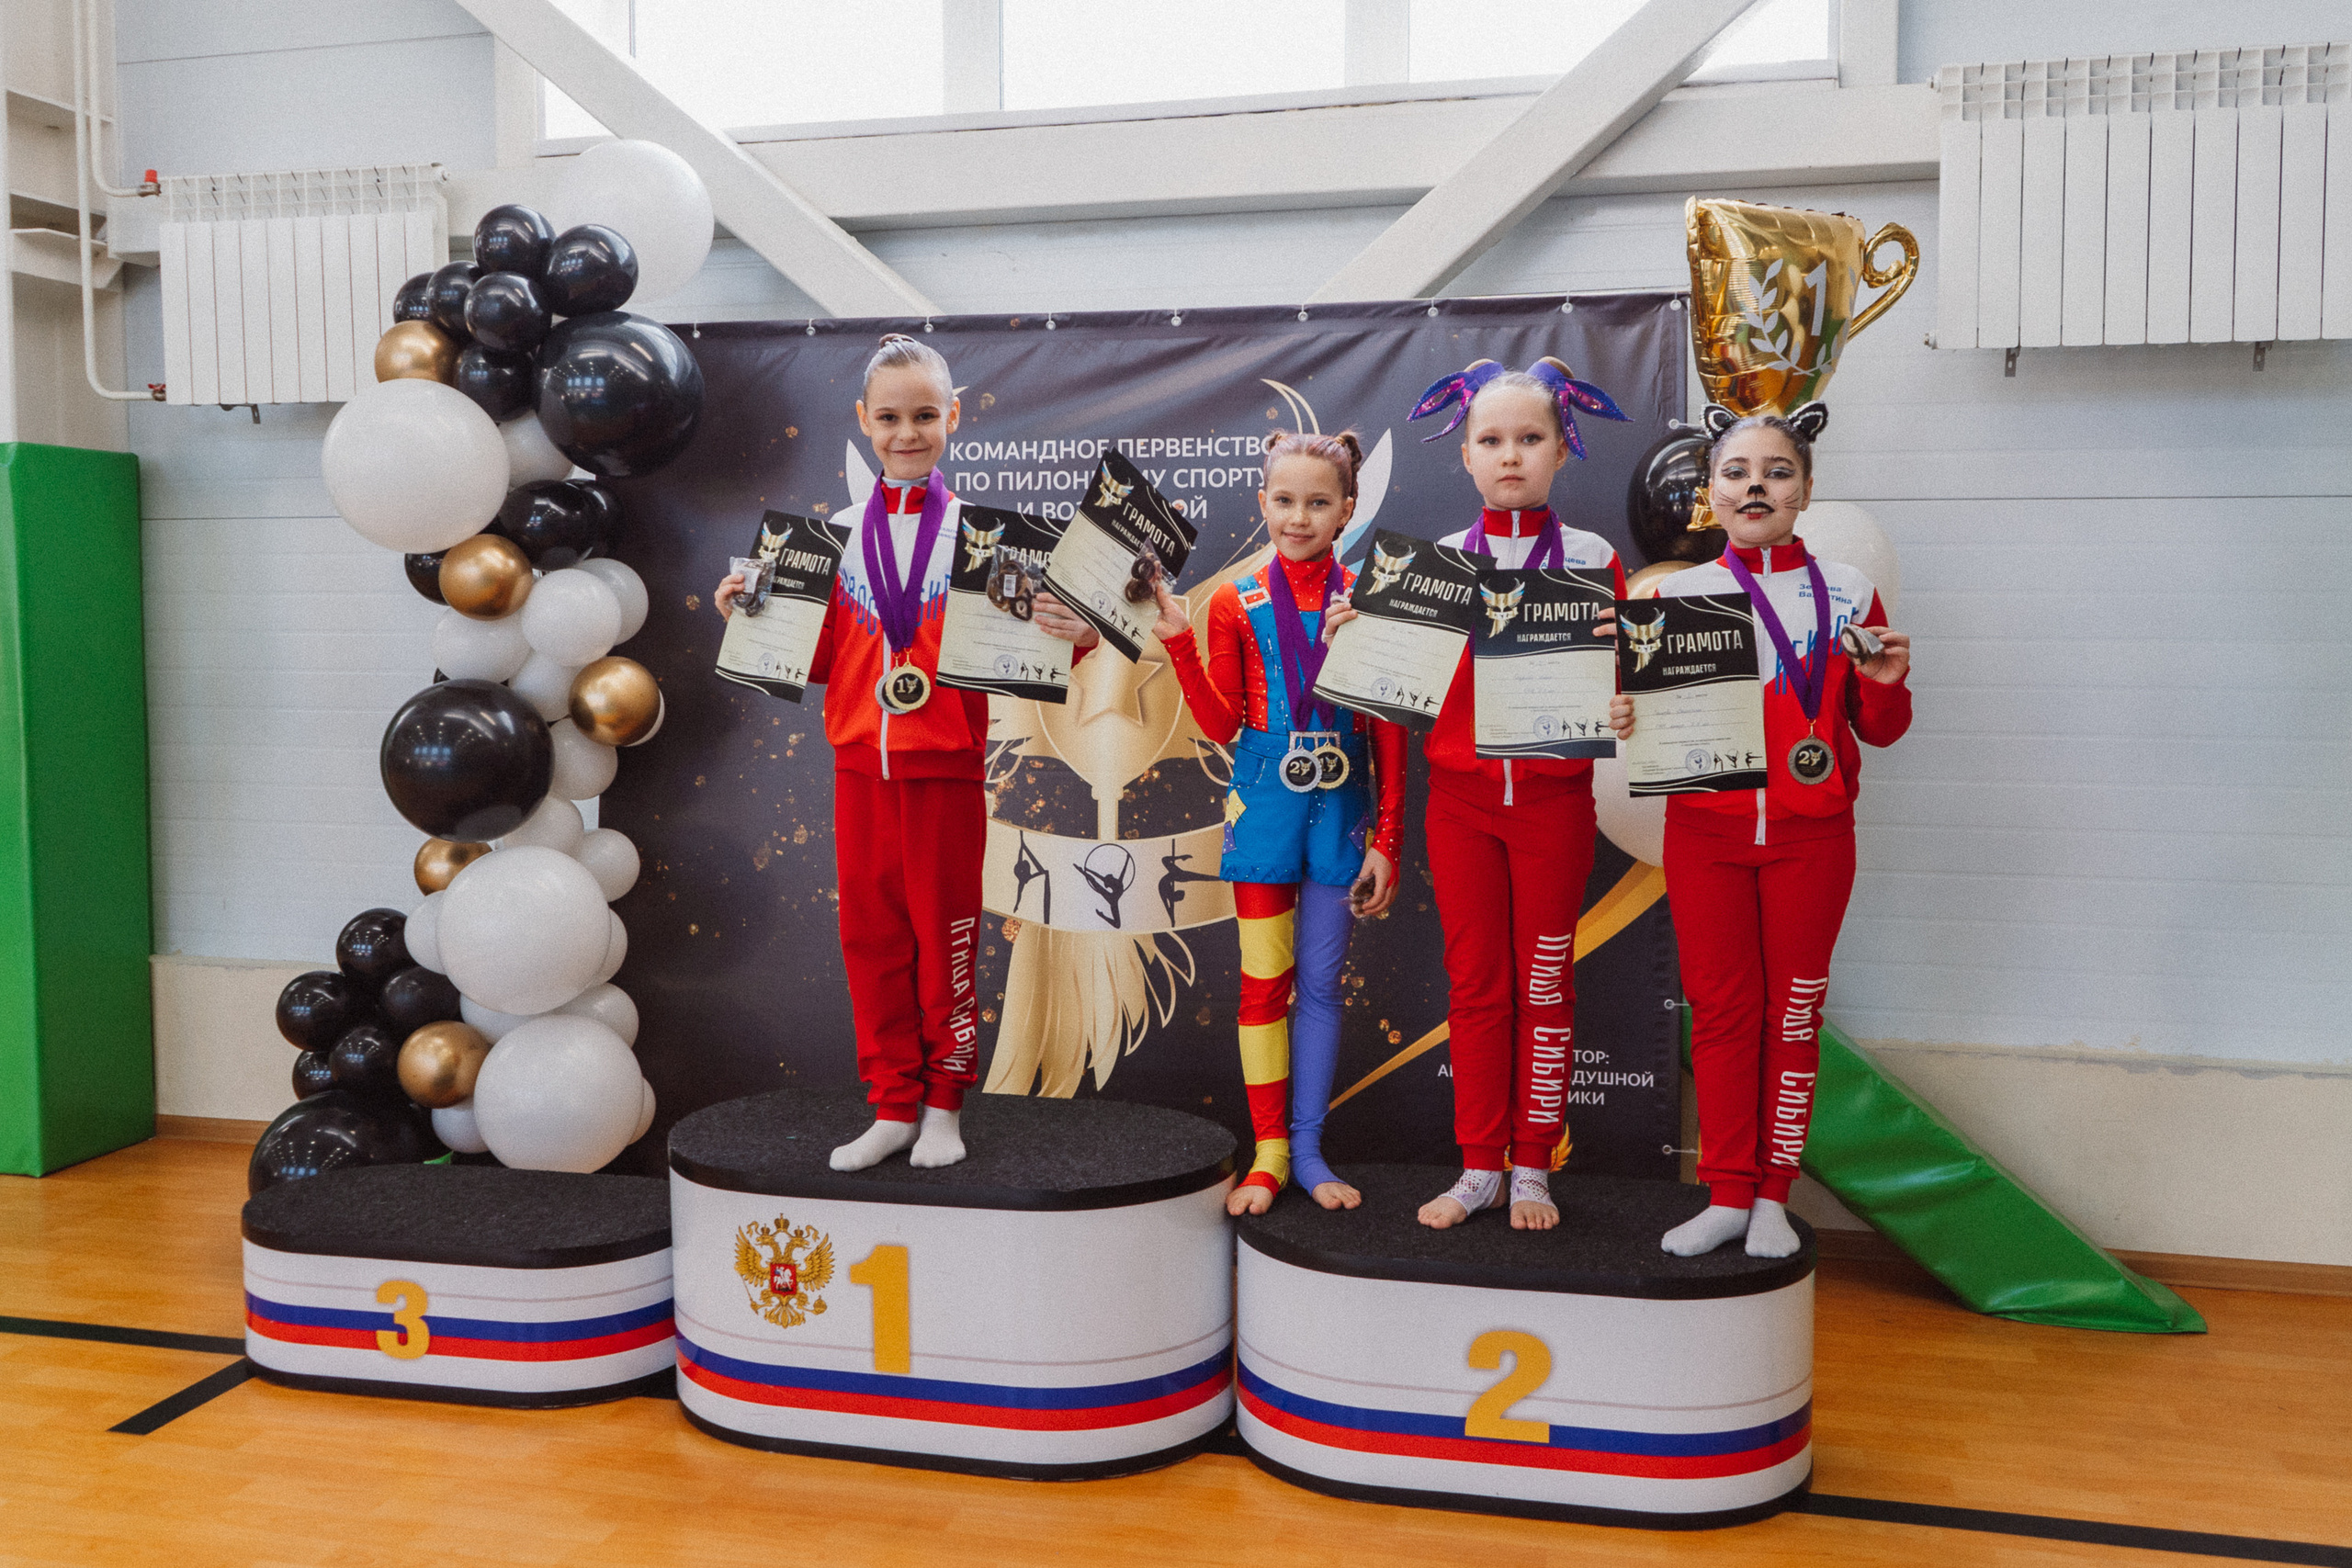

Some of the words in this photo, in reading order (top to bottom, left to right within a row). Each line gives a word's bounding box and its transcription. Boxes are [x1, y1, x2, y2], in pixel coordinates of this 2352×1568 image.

[1804, 259, 1827, 336] 1
[950, 439, 1109, 463] КОМАНДНОЕ
[956, 471, 990, 491] ПО
[998, 470, 1166, 491] ПИЛОНУ
[1173, 468, 1264, 489] СПОРТУ
[1112, 518, 1144, 548] НАГРАЖДАЕТ
[1122, 502, 1177, 558] ГРАМОТА
[779, 547, 831, 576] ГРАМОТА
[1000, 546, 1053, 569] ГРАМО
[1402, 571, 1473, 605] ГРАМОТА
[1388, 598, 1438, 618] НАГРАЖДАЕТСЯ
[1523, 602, 1600, 623] ГРАМОТА
[1516, 632, 1572, 643] НАГРАЖДАЕТСЯ
[1667, 629, 1744, 655] ГРАМОТА
[1662, 663, 1717, 676] НАГРАЖДАЕТСЯ
[896, 678, 907, 694] 1
[1289, 761, 1301, 774] 2
[1798, 750, 1811, 765] 2
[951, 917, 976, 998] ПТИЦА
[1529, 932, 1572, 1006] ПТИЦА
[1527, 1026, 1571, 1123] СИБИРИ
[1770, 1070, 1816, 1168] СИБИРИ
[375, 1280, 431, 1360] 3
[850, 1245, 912, 1374] 1
[1464, 1329, 1553, 1444] 2
